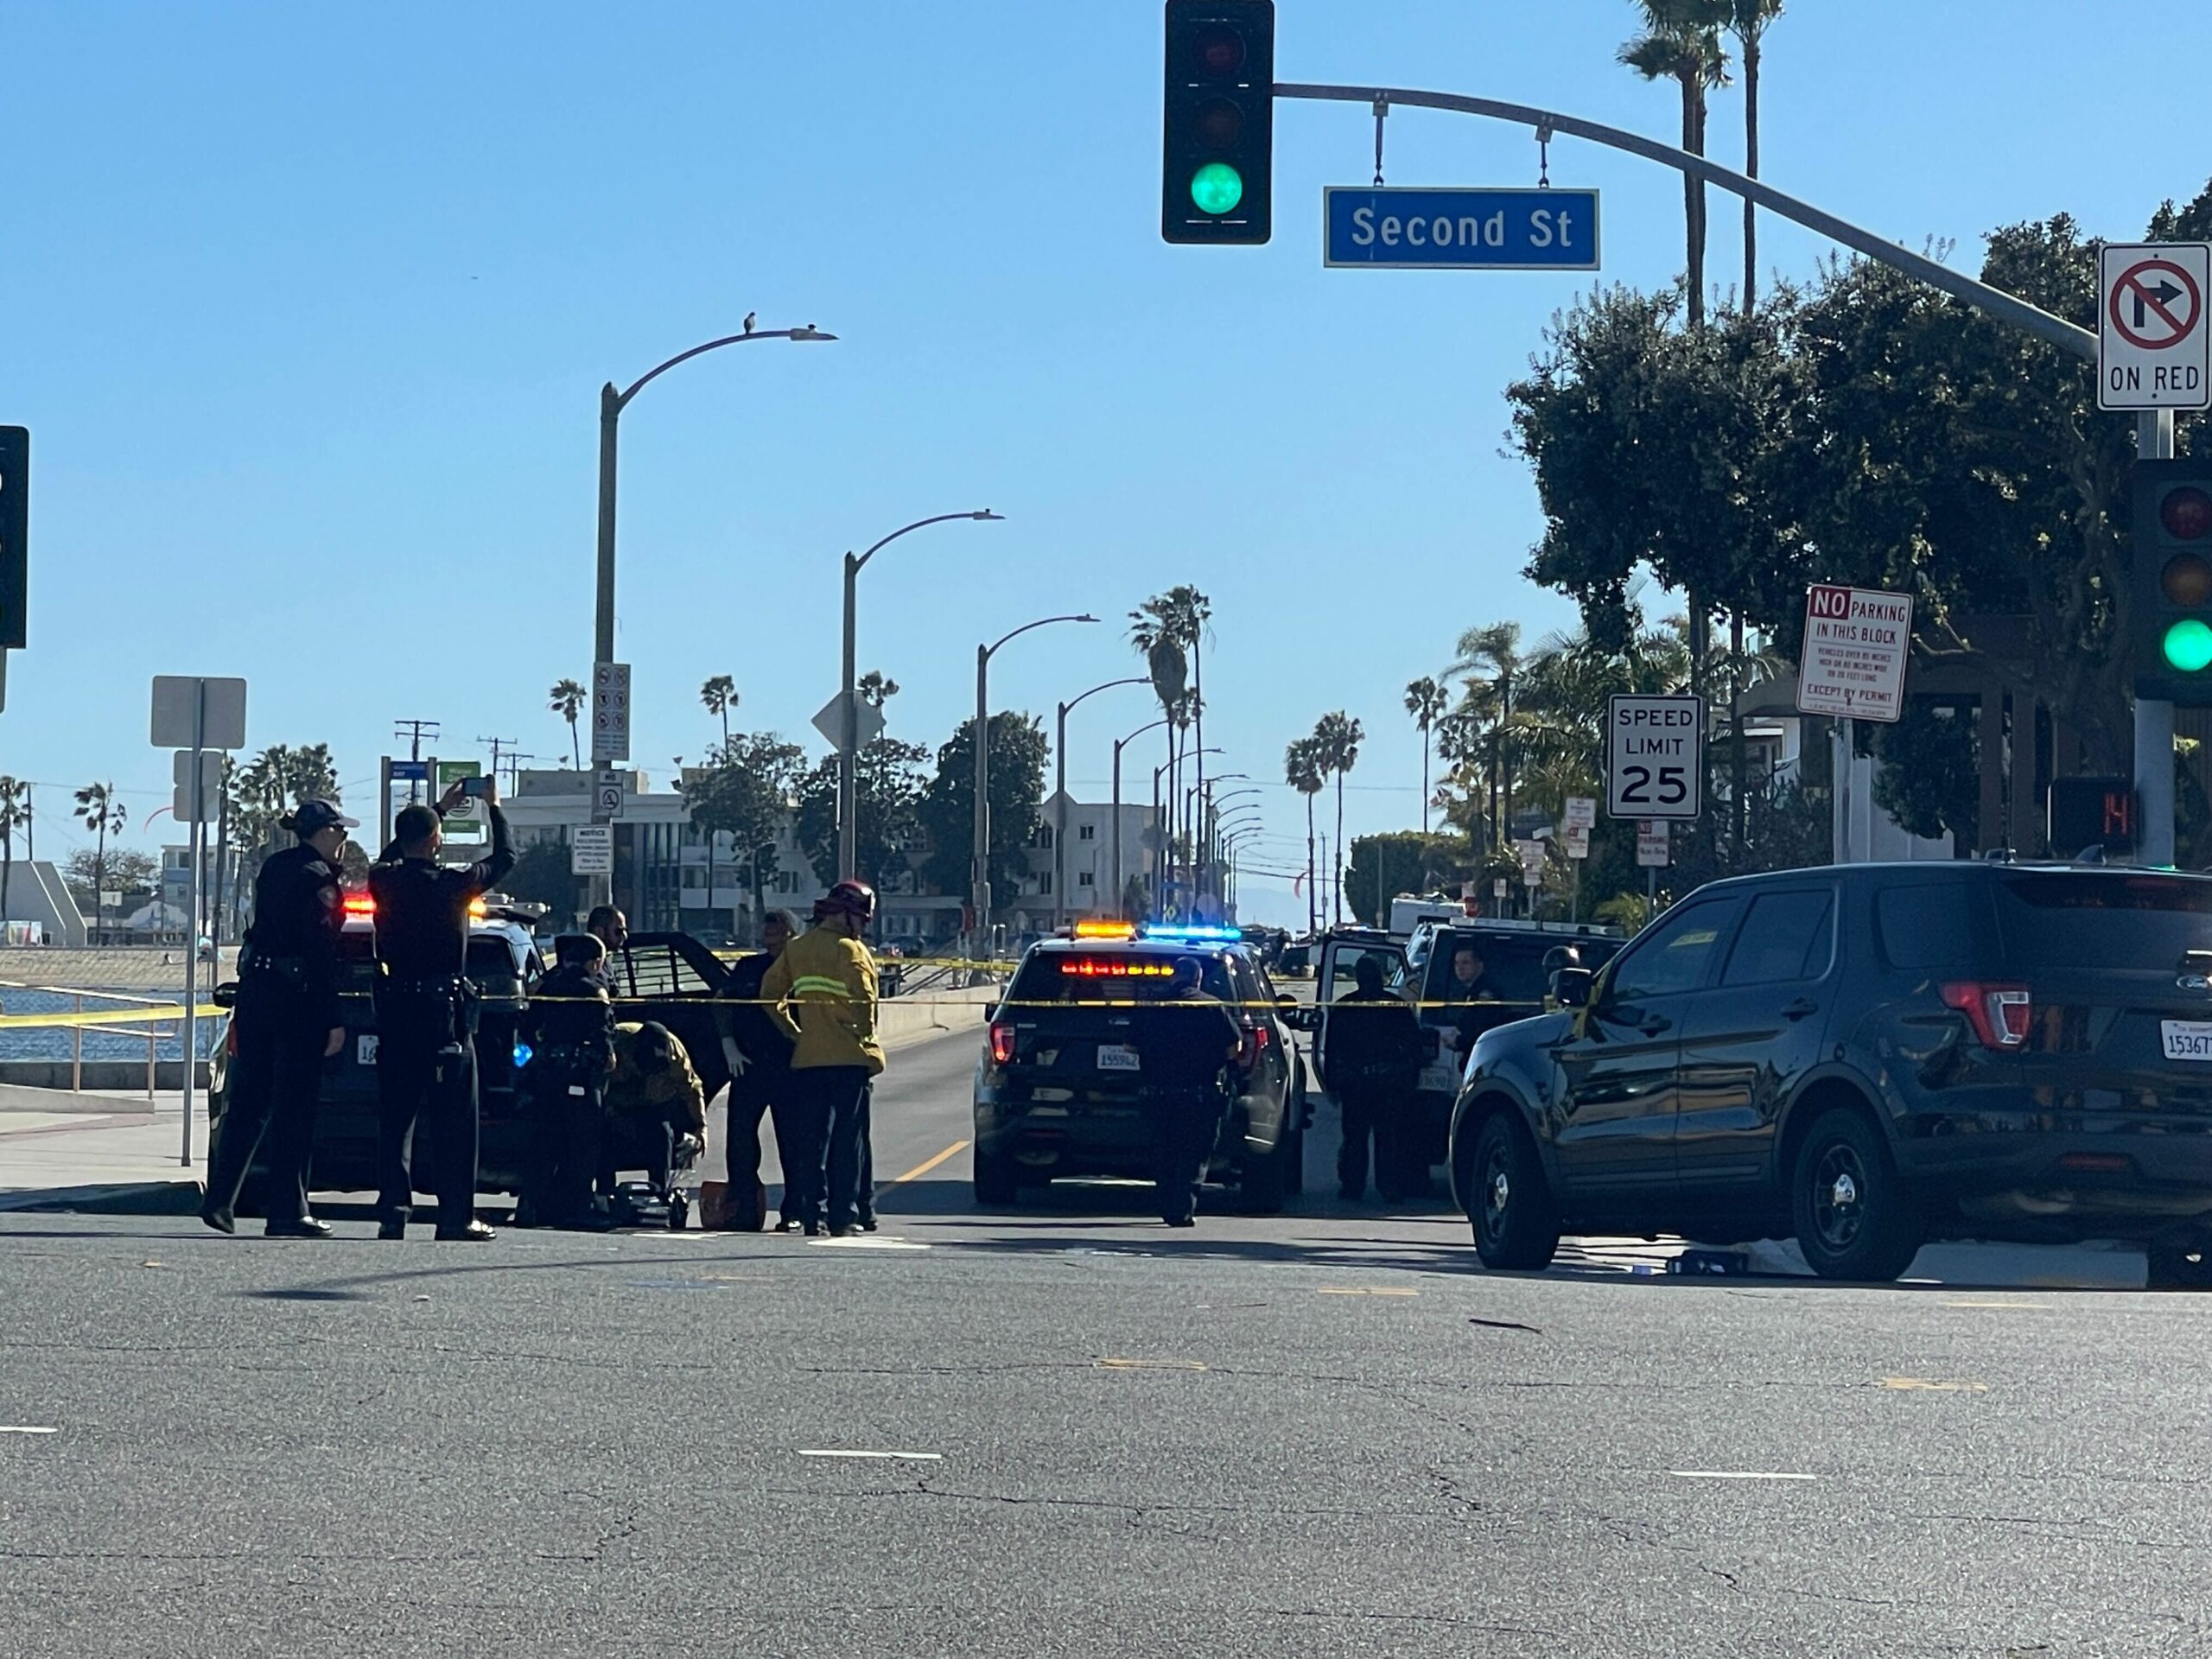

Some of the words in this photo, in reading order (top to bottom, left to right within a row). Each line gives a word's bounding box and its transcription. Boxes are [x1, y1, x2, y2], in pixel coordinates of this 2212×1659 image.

[1351, 207, 1504, 247] Second
[1529, 209, 1573, 248] St
[2110, 365, 2140, 391] ON
[2154, 365, 2199, 391] RED
[1814, 590, 1846, 617] NO
[1851, 601, 1905, 623] PARKING
[1816, 622, 1828, 638] IN
[1833, 624, 1858, 641] THIS
[1861, 627, 1897, 645] BLOCK
[1846, 651, 1860, 659] OVER
[1872, 653, 1891, 663] INCHES
[1808, 683, 1841, 697] EXCEPT
[1844, 687, 1856, 698] BY
[1859, 690, 1892, 702] PERMIT
[1618, 709, 1693, 727] SPEED
[1625, 738, 1684, 755] LIMIT
[1620, 766, 1687, 804] 25
[2170, 1035, 2212, 1054] 15367
